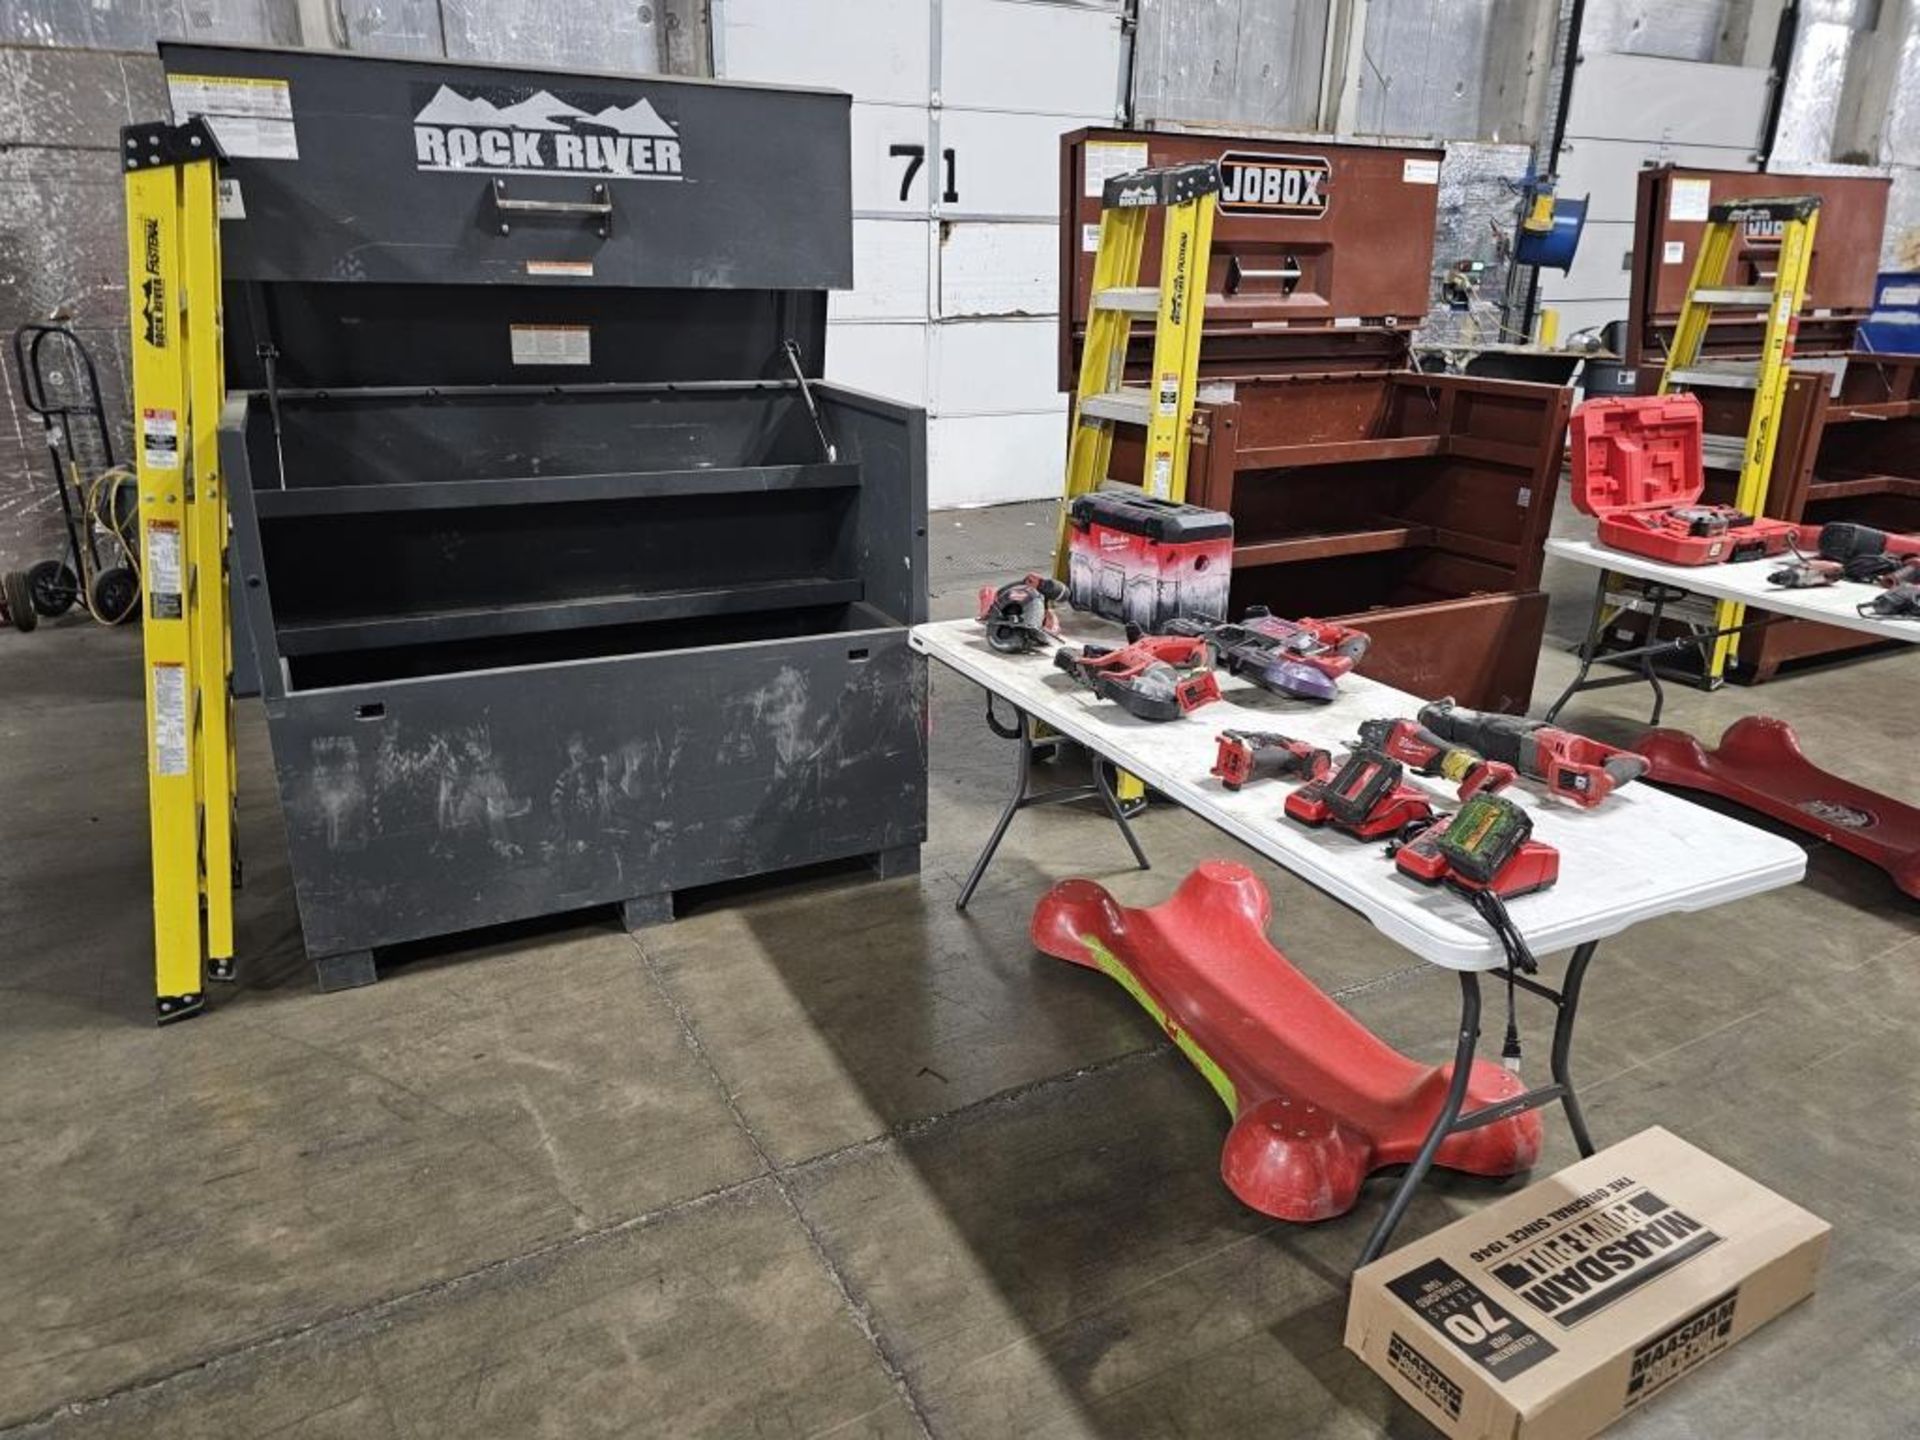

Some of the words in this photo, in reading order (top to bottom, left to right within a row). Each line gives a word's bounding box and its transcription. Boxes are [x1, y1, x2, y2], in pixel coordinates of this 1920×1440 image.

[414, 126, 544, 168] ROCK
[555, 134, 682, 174] RIVER
[1222, 165, 1322, 206] JOBOX
[152, 277, 165, 313] RIVER
[153, 315, 166, 348] ROCK
[1606, 1176, 1636, 1193] THE
[1548, 1188, 1611, 1222] ORIGINAL
[1506, 1218, 1551, 1244] SINCE
[1469, 1240, 1509, 1263] 1946
[1519, 1210, 1704, 1313] MAASDAM
[1427, 1287, 1479, 1320] YEARS
[1443, 1301, 1512, 1345] 70
[1632, 1298, 1737, 1378] MAASDAM
[1389, 1338, 1462, 1401] MAASDAM
